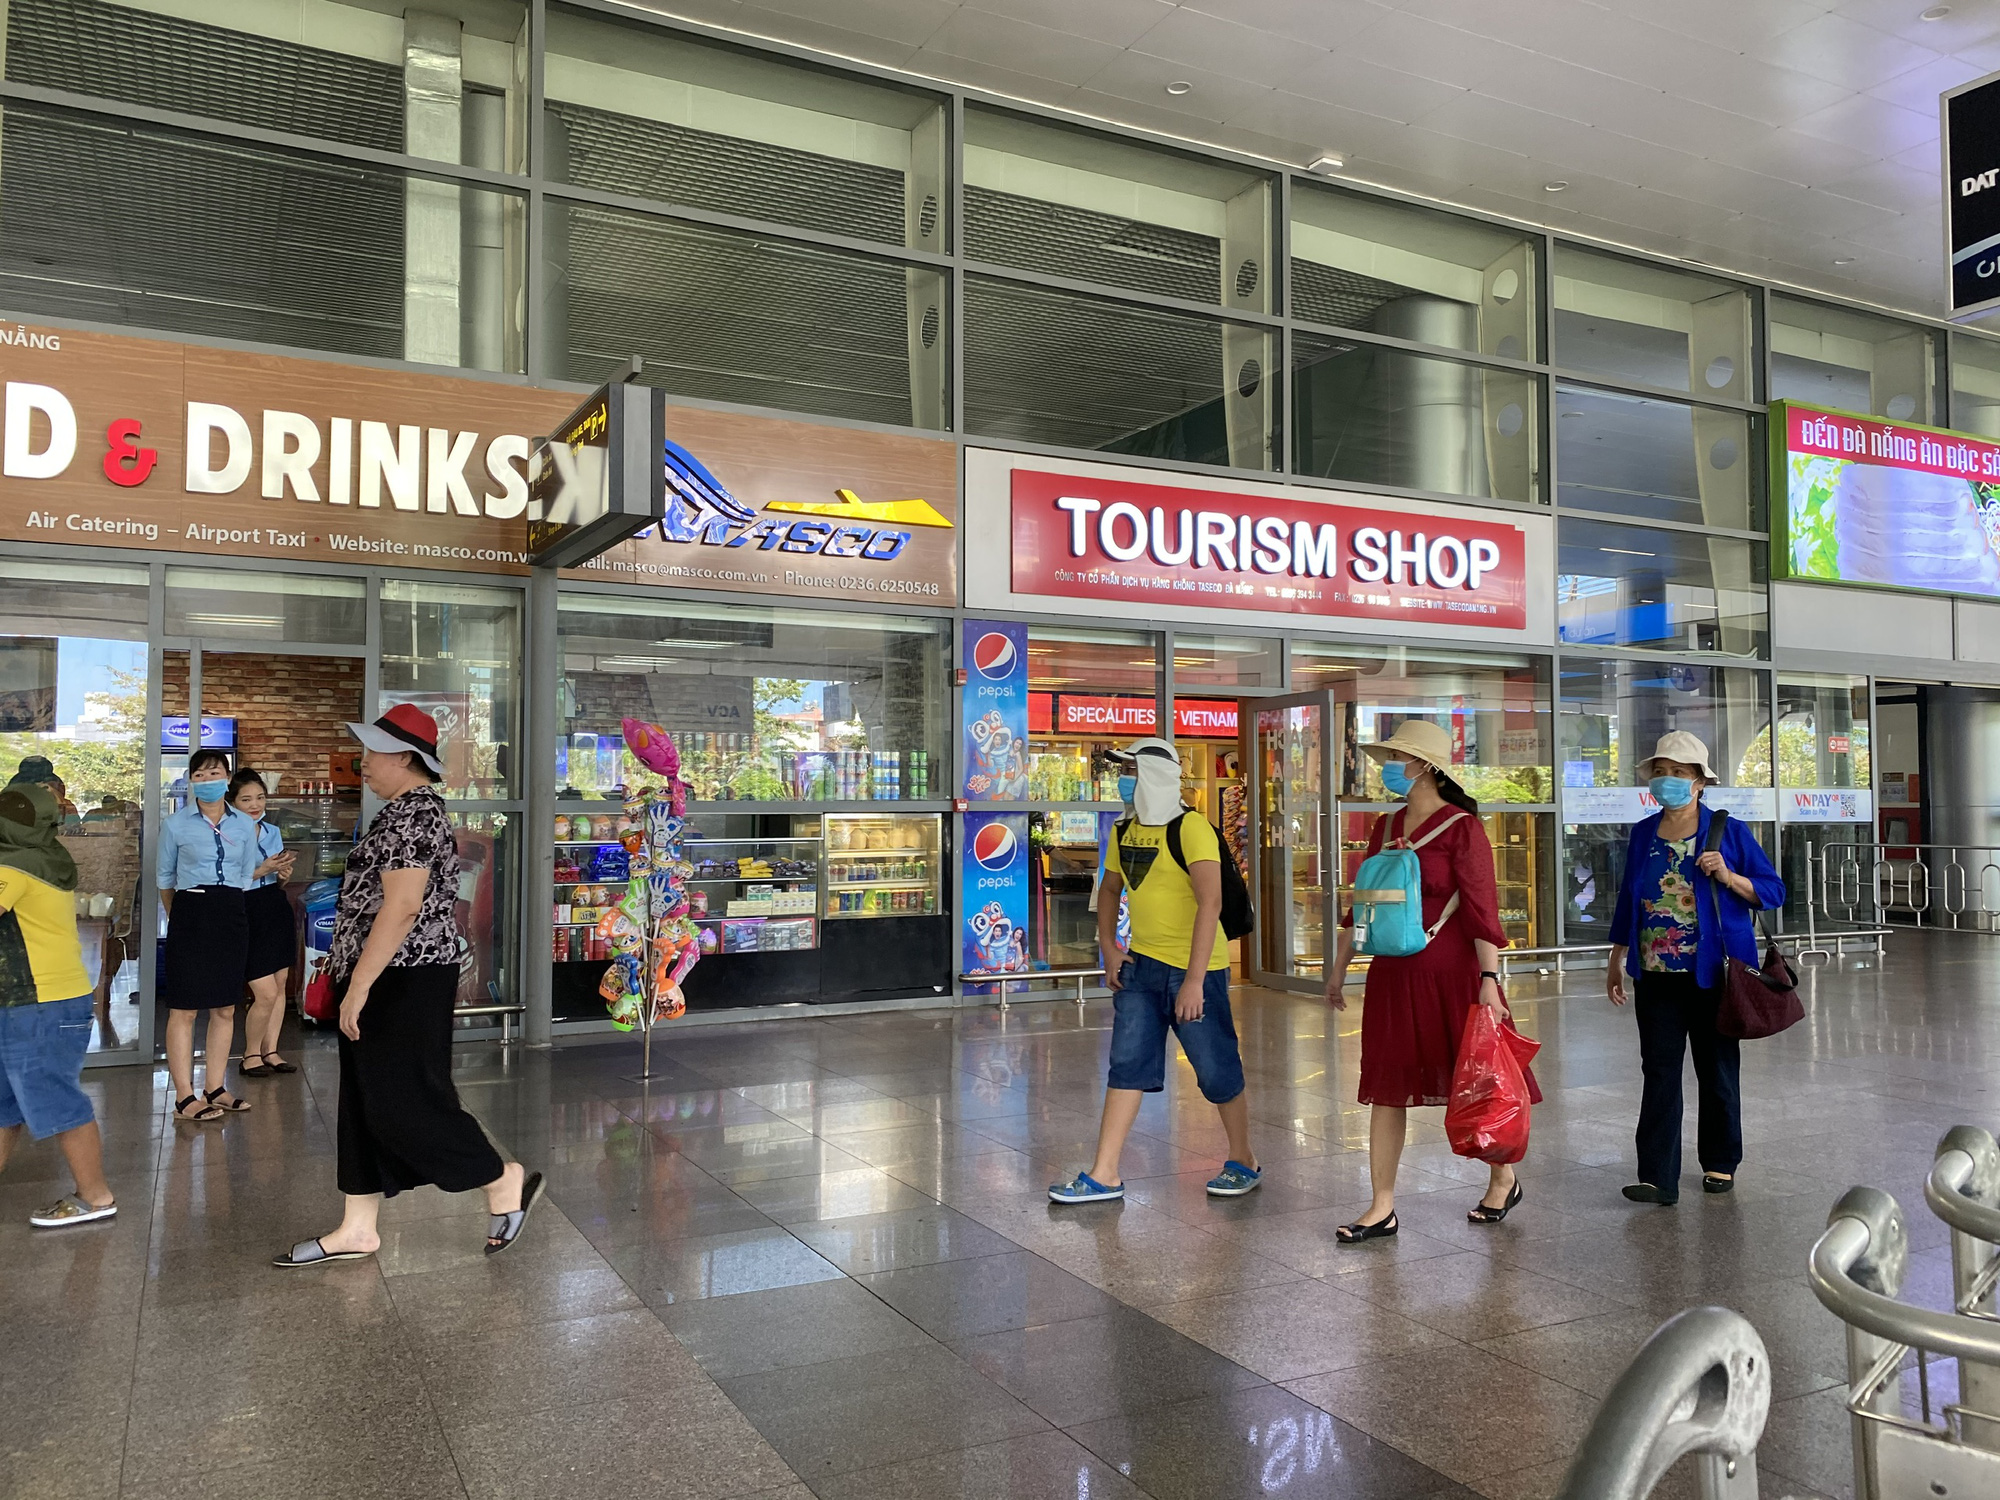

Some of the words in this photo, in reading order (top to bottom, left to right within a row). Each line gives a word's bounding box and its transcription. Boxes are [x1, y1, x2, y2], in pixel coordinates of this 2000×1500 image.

[103, 418, 157, 487] &
[186, 401, 528, 519] DRINKS
[1802, 416, 1839, 450] ĐẾN
[1842, 425, 1866, 454] ĐÀ
[1871, 426, 1916, 462] NẴNG
[1920, 436, 1943, 467] ĂN
[1946, 443, 1979, 474] ĐẶC
[26, 511, 59, 529] Air
[65, 513, 159, 541] Catering
[185, 523, 261, 545] Airport
[266, 529, 306, 548] Taxi
[328, 533, 409, 555] Website:
[1056, 495, 1337, 580] TOURISM
[1351, 526, 1501, 591] SHOP
[613, 560, 767, 582] masco@masco.com.vn
[785, 570, 836, 588] Phone:
[839, 575, 939, 595] 0236.6250548
[1055, 568, 1075, 582] CÔNG
[1077, 572, 1087, 582] TY
[1122, 576, 1138, 588] DỊCH
[1140, 577, 1150, 589] VỤ
[1152, 576, 1170, 589] HÀNG
[1173, 577, 1195, 591] KHÔNG
[1198, 581, 1223, 594] TASECO
[978, 685, 1013, 698] pepsi
[1067, 705, 1156, 725] SPECALITIES
[1180, 710, 1238, 728] VIETNAM
[1799, 807, 1811, 816] Scan
[1819, 808, 1829, 817] Pay
[978, 875, 1013, 891] pepsi
